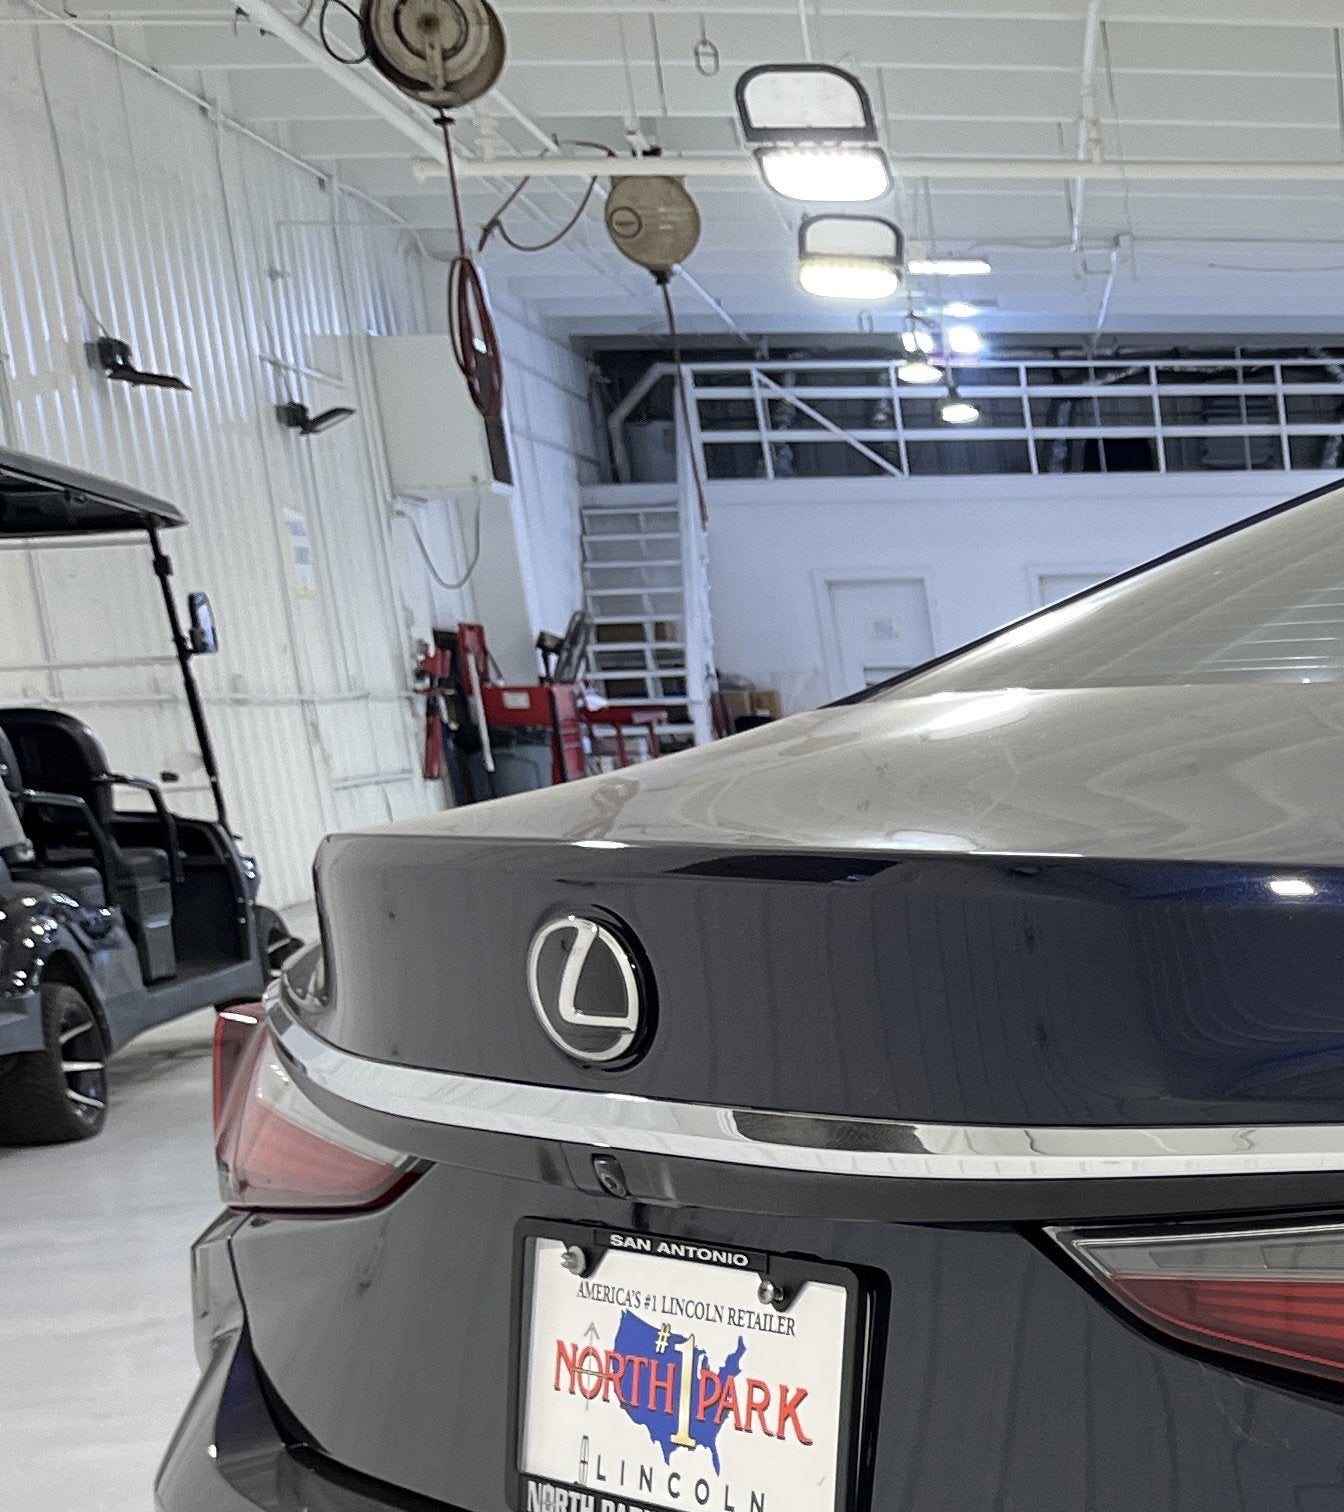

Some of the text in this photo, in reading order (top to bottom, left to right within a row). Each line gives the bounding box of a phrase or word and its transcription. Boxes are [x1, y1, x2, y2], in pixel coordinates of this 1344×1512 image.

[609, 1233, 749, 1267] SAN ANTONIO
[576, 1281, 797, 1337] AMERICA'S #1 LINCOLN RETAILER
[553, 1339, 814, 1446] NORTH PARK
